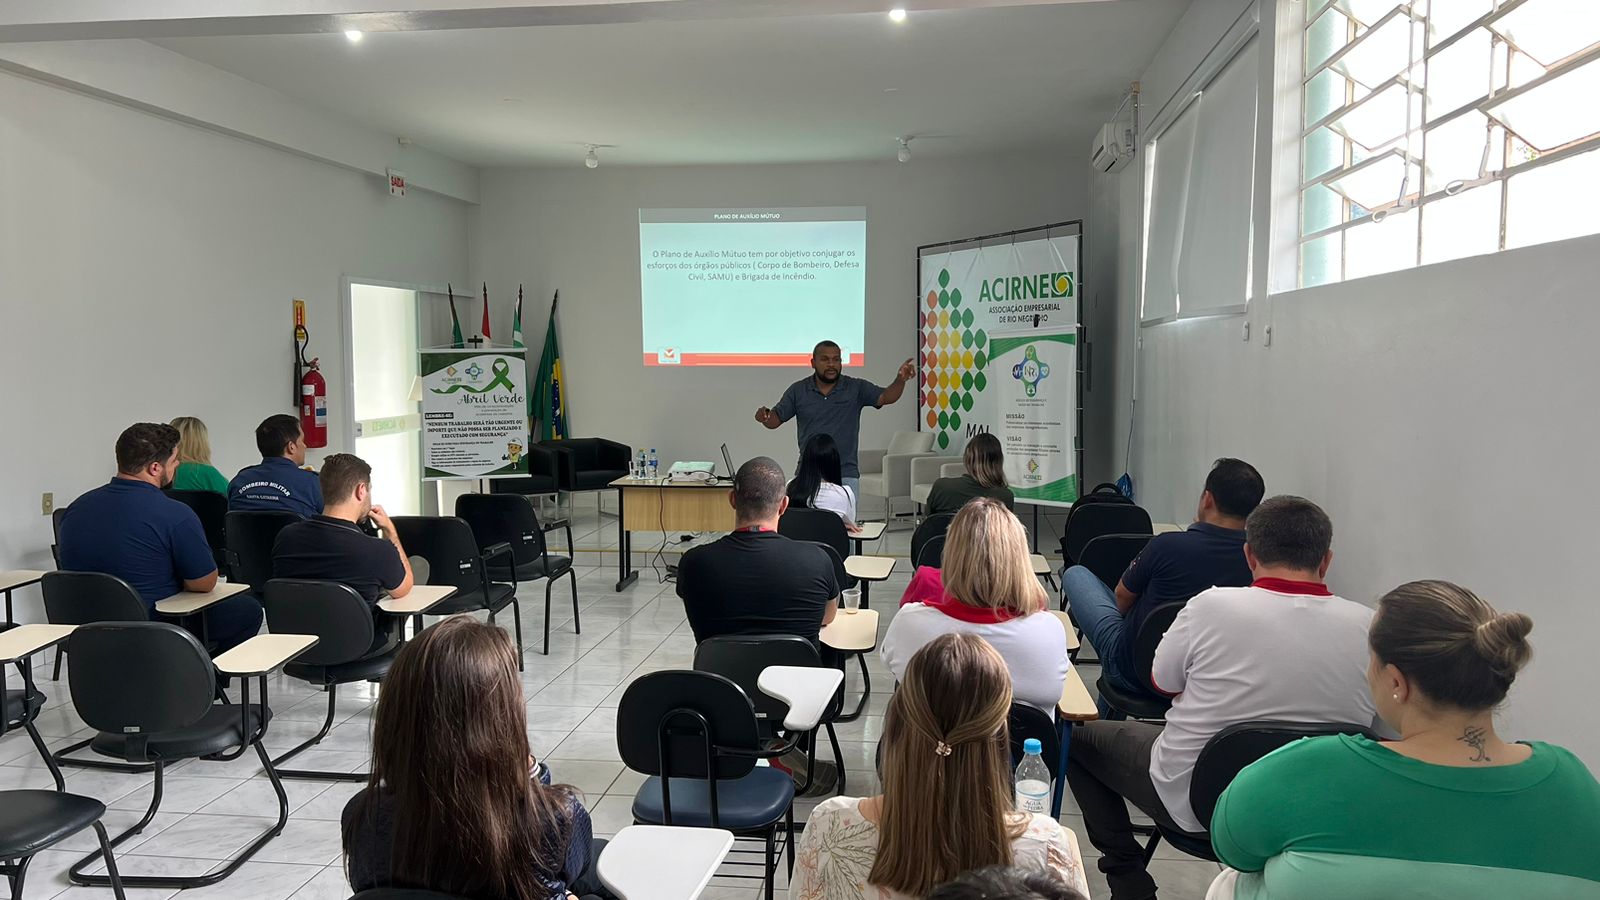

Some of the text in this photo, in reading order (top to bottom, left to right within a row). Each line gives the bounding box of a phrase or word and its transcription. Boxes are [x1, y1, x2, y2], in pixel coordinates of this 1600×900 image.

[652, 250, 660, 258] O
[661, 250, 682, 258] Plano
[684, 250, 693, 258] de
[694, 250, 719, 258] Auxílio
[721, 250, 747, 258] Mútuo
[780, 250, 811, 260] objetivo
[812, 250, 845, 259] conjugar
[646, 261, 678, 270] esforços
[679, 261, 692, 269] dos
[694, 261, 718, 270] órgãos
[720, 261, 751, 270] públicos
[757, 261, 780, 270] Corpo
[781, 261, 792, 269] de
[793, 260, 832, 269] Bombeiro,
[834, 260, 860, 268] Defesa
[688, 273, 706, 281] Civil,
[707, 273, 734, 281] SAMU)
[742, 273, 770, 281] Brigada
[771, 272, 781, 280] de
[782, 272, 817, 280] Incêndio.
[989, 303, 1061, 314] ASSOCIAÇÃO EMPRESARIAL
[1007, 315, 1016, 323] RIO
[457, 392, 525, 405] Abril Verde
[238, 481, 291, 497] BOMBEIRO MILITAR
